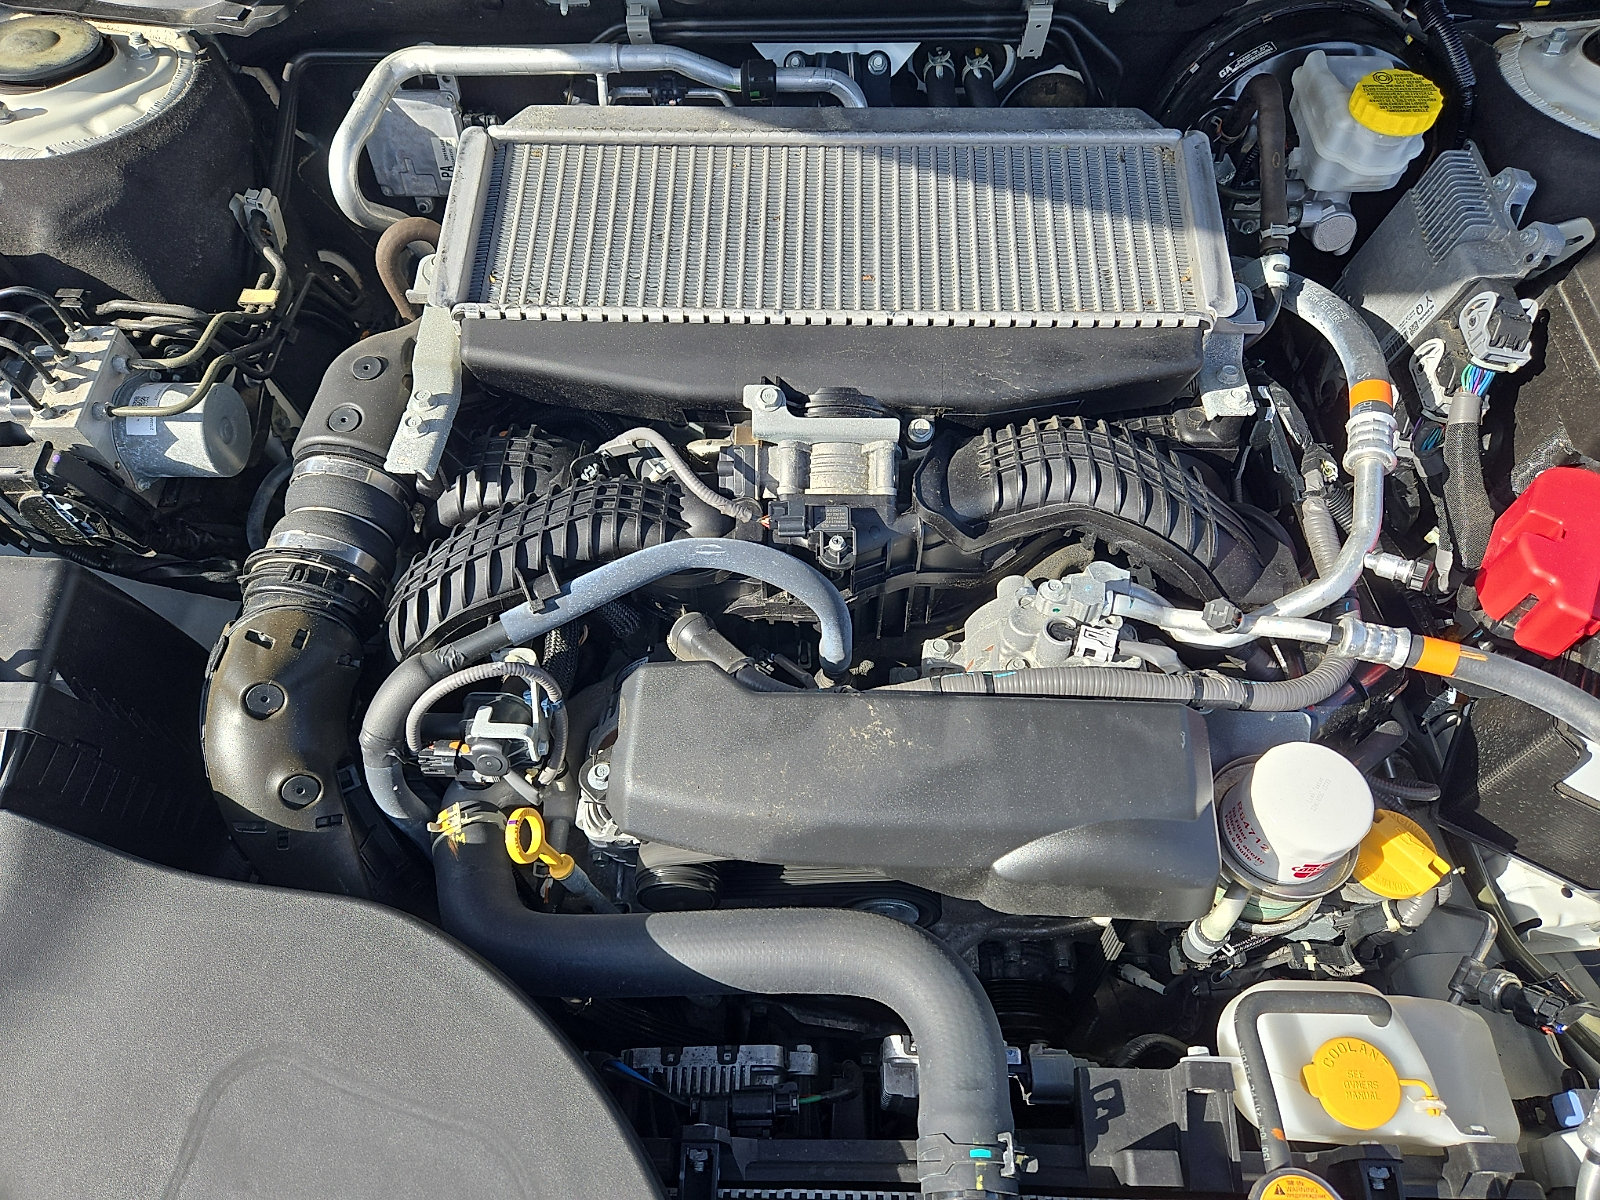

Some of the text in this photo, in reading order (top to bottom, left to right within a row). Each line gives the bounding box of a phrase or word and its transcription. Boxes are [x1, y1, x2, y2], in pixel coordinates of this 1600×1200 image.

[440, 165, 453, 178] PA
[1346, 1069, 1365, 1079] SEE
[1344, 1090, 1381, 1101] MANUAL
